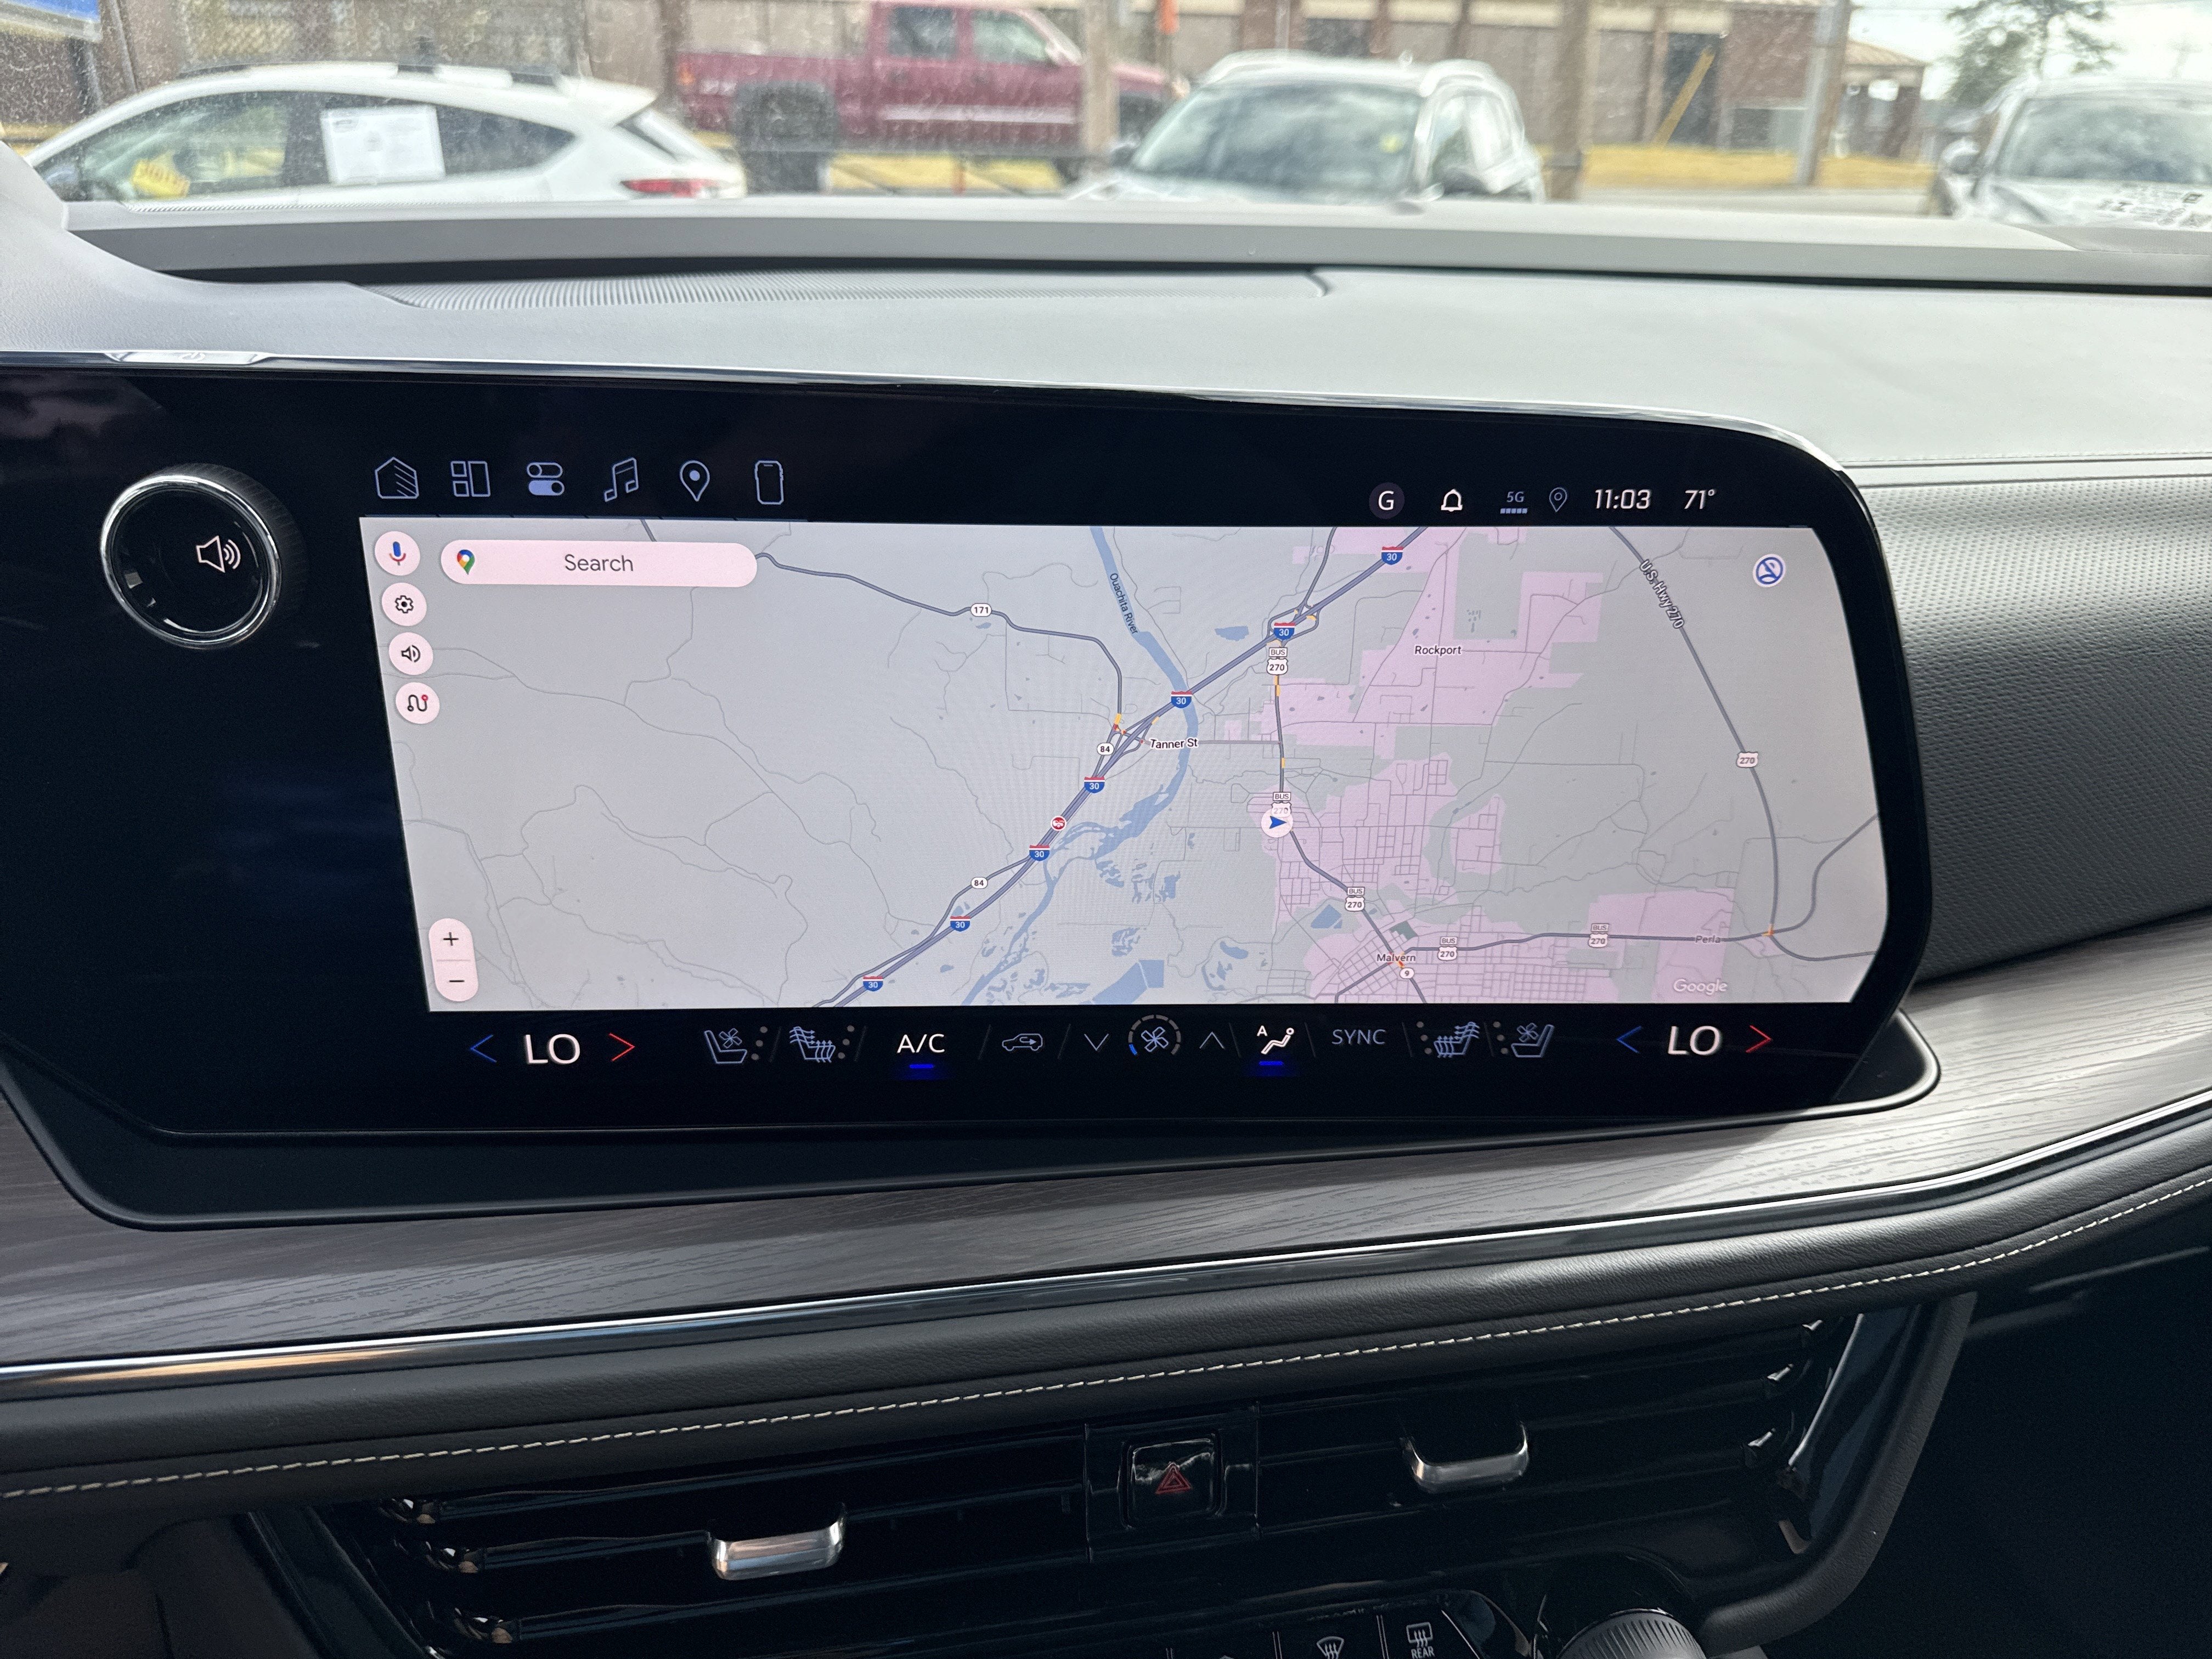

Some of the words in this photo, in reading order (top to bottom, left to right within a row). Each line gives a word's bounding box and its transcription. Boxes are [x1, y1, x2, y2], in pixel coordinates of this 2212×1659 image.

[1378, 492, 1394, 510] G
[1506, 492, 1524, 503] 5G
[1594, 489, 1651, 510] 11:03
[1684, 489, 1716, 510] 71°
[1386, 552, 1397, 561] 30
[565, 554, 634, 572] Search
[1640, 560, 1657, 584] U.S.
[1652, 582, 1672, 607] Hwy
[1666, 606, 1684, 628] 270
[1110, 573, 1128, 612] Ouachita
[1124, 612, 1138, 634] River
[974, 606, 989, 614] 171
[1279, 628, 1289, 637] 30
[1415, 645, 1462, 656] Rockport
[1269, 663, 1285, 673] 270
[1176, 697, 1186, 705] 30
[1150, 738, 1184, 749] Tanner
[1187, 738, 1198, 747] St
[1034, 850, 1045, 859] 30
[955, 921, 966, 929] 30
[1695, 935, 1721, 944] Perla
[1376, 952, 1416, 963] Malvern
[1440, 950, 1455, 958] 270
[868, 981, 878, 989] 30
[1673, 978, 1727, 995] Google
[1257, 1025, 1268, 1037] A
[1332, 1029, 1386, 1045] SYNC
[1668, 1025, 1722, 1056] LO
[896, 1034, 945, 1053] A/C
[524, 1034, 580, 1065] LO
[1410, 1646, 1435, 1659] REAR
